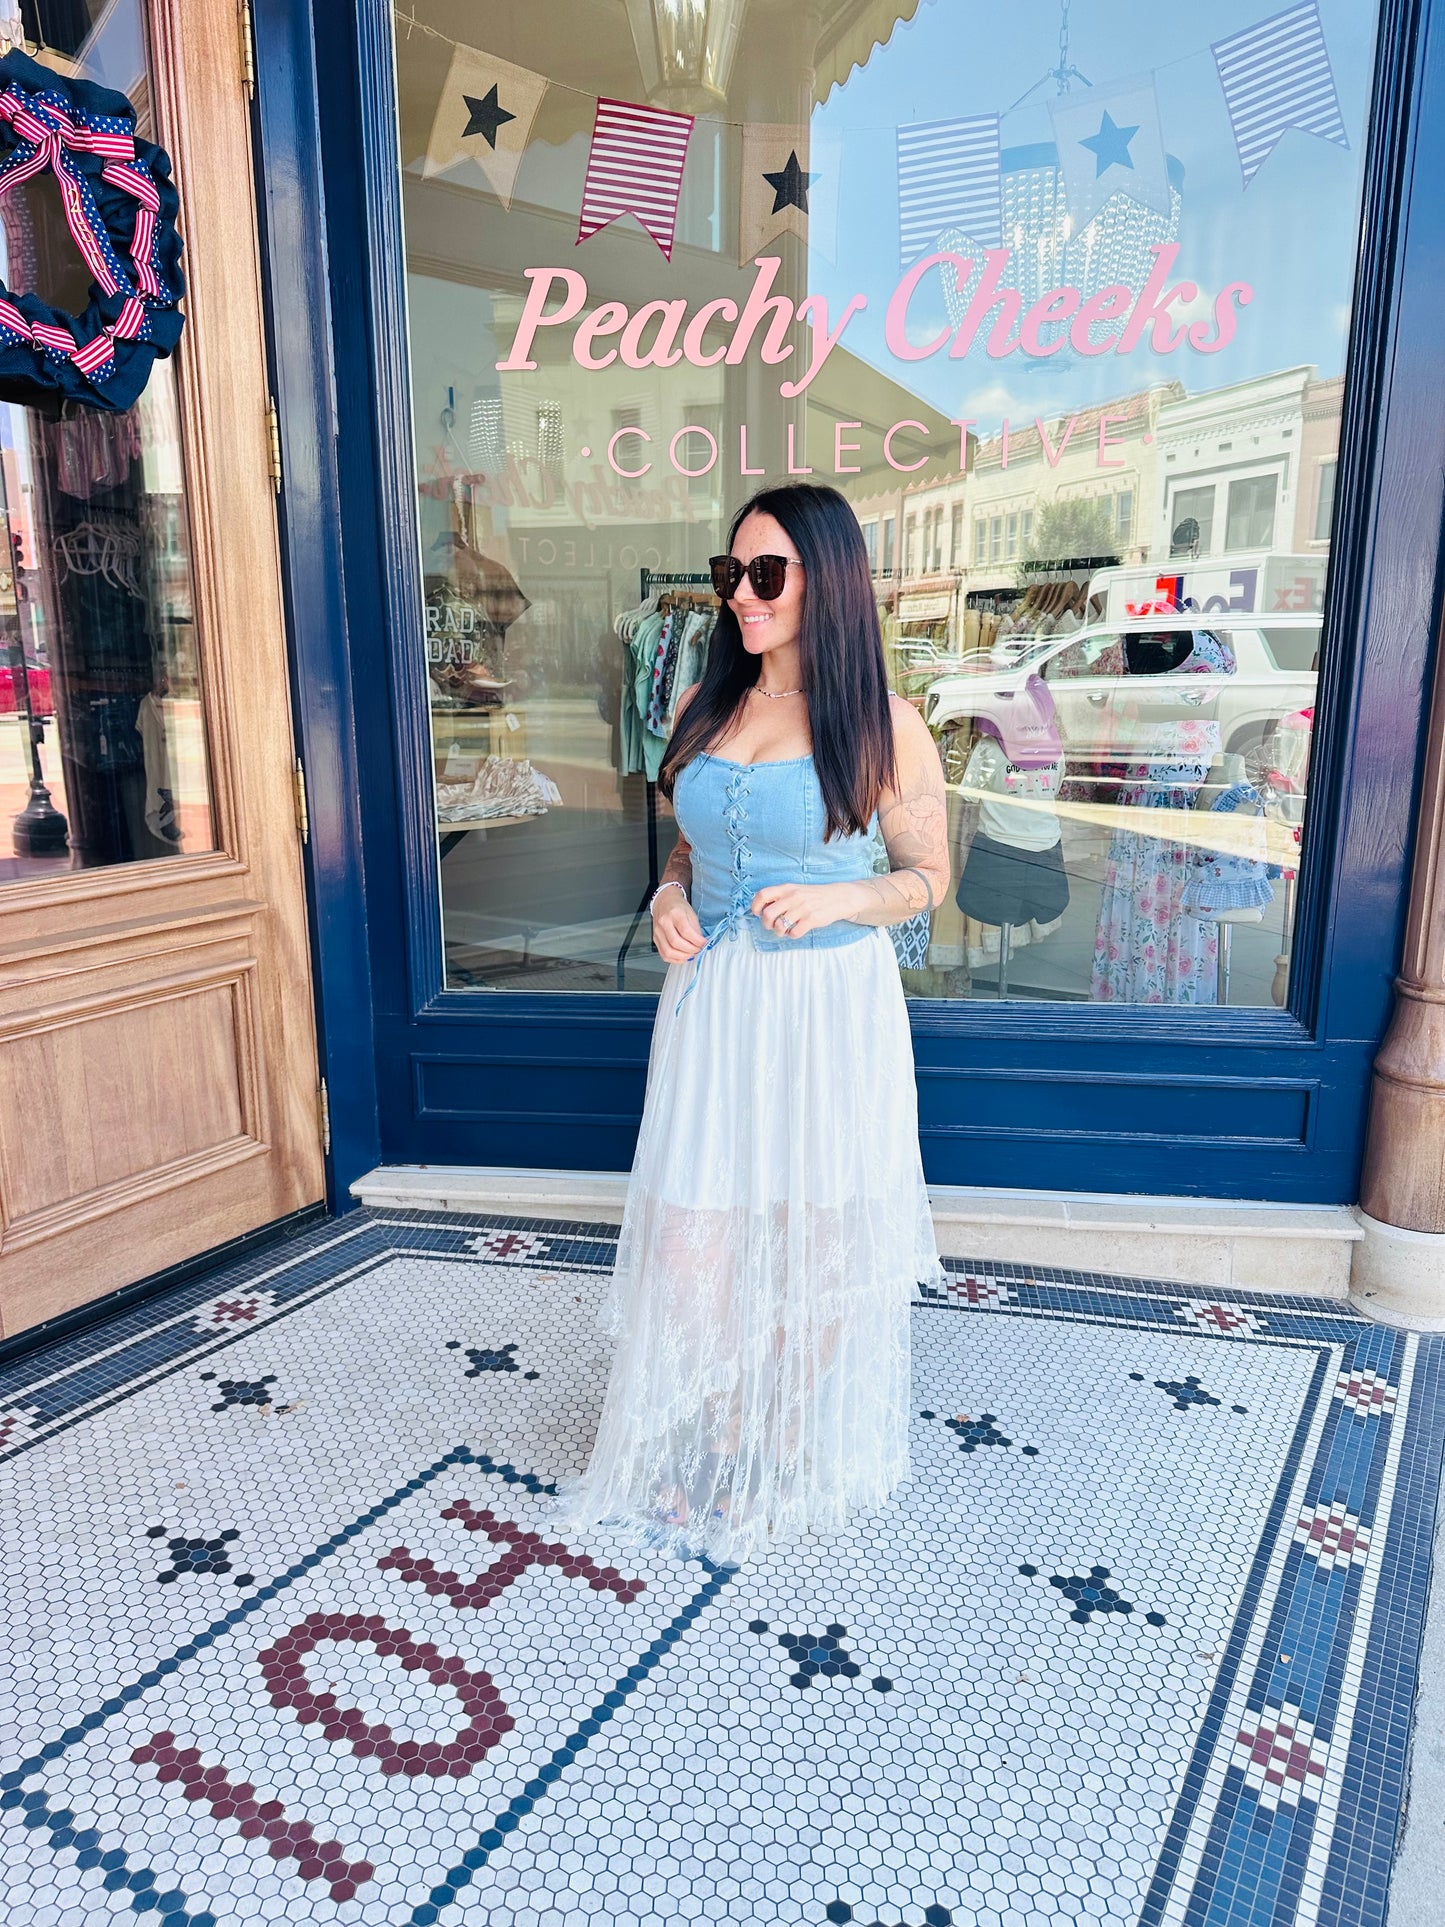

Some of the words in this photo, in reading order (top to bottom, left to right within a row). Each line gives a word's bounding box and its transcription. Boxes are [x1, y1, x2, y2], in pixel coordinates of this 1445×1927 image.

[496, 257, 866, 398] Peachy
[885, 243, 1254, 361] Cheeks
[607, 416, 1126, 478] COLLECTIVE
[425, 607, 474, 633] RAD
[428, 638, 473, 664] DAD
